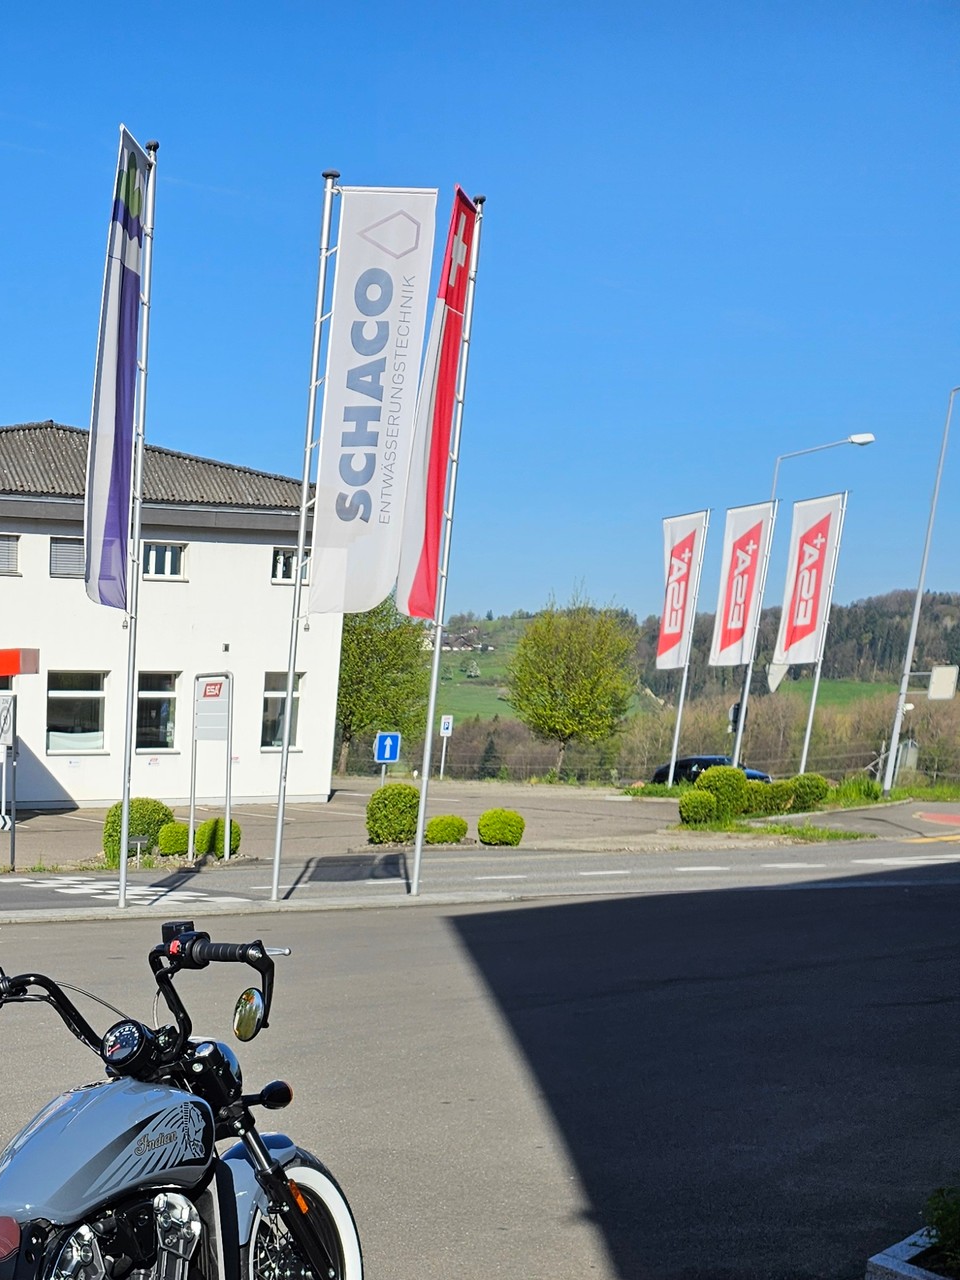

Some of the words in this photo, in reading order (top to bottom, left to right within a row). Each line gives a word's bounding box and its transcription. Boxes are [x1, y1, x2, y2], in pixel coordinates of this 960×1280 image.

[335, 267, 394, 524] SCHACO
[378, 274, 416, 525] ENTWÄSSERUNGSTECHNIK
[134, 1130, 178, 1156] Indian
